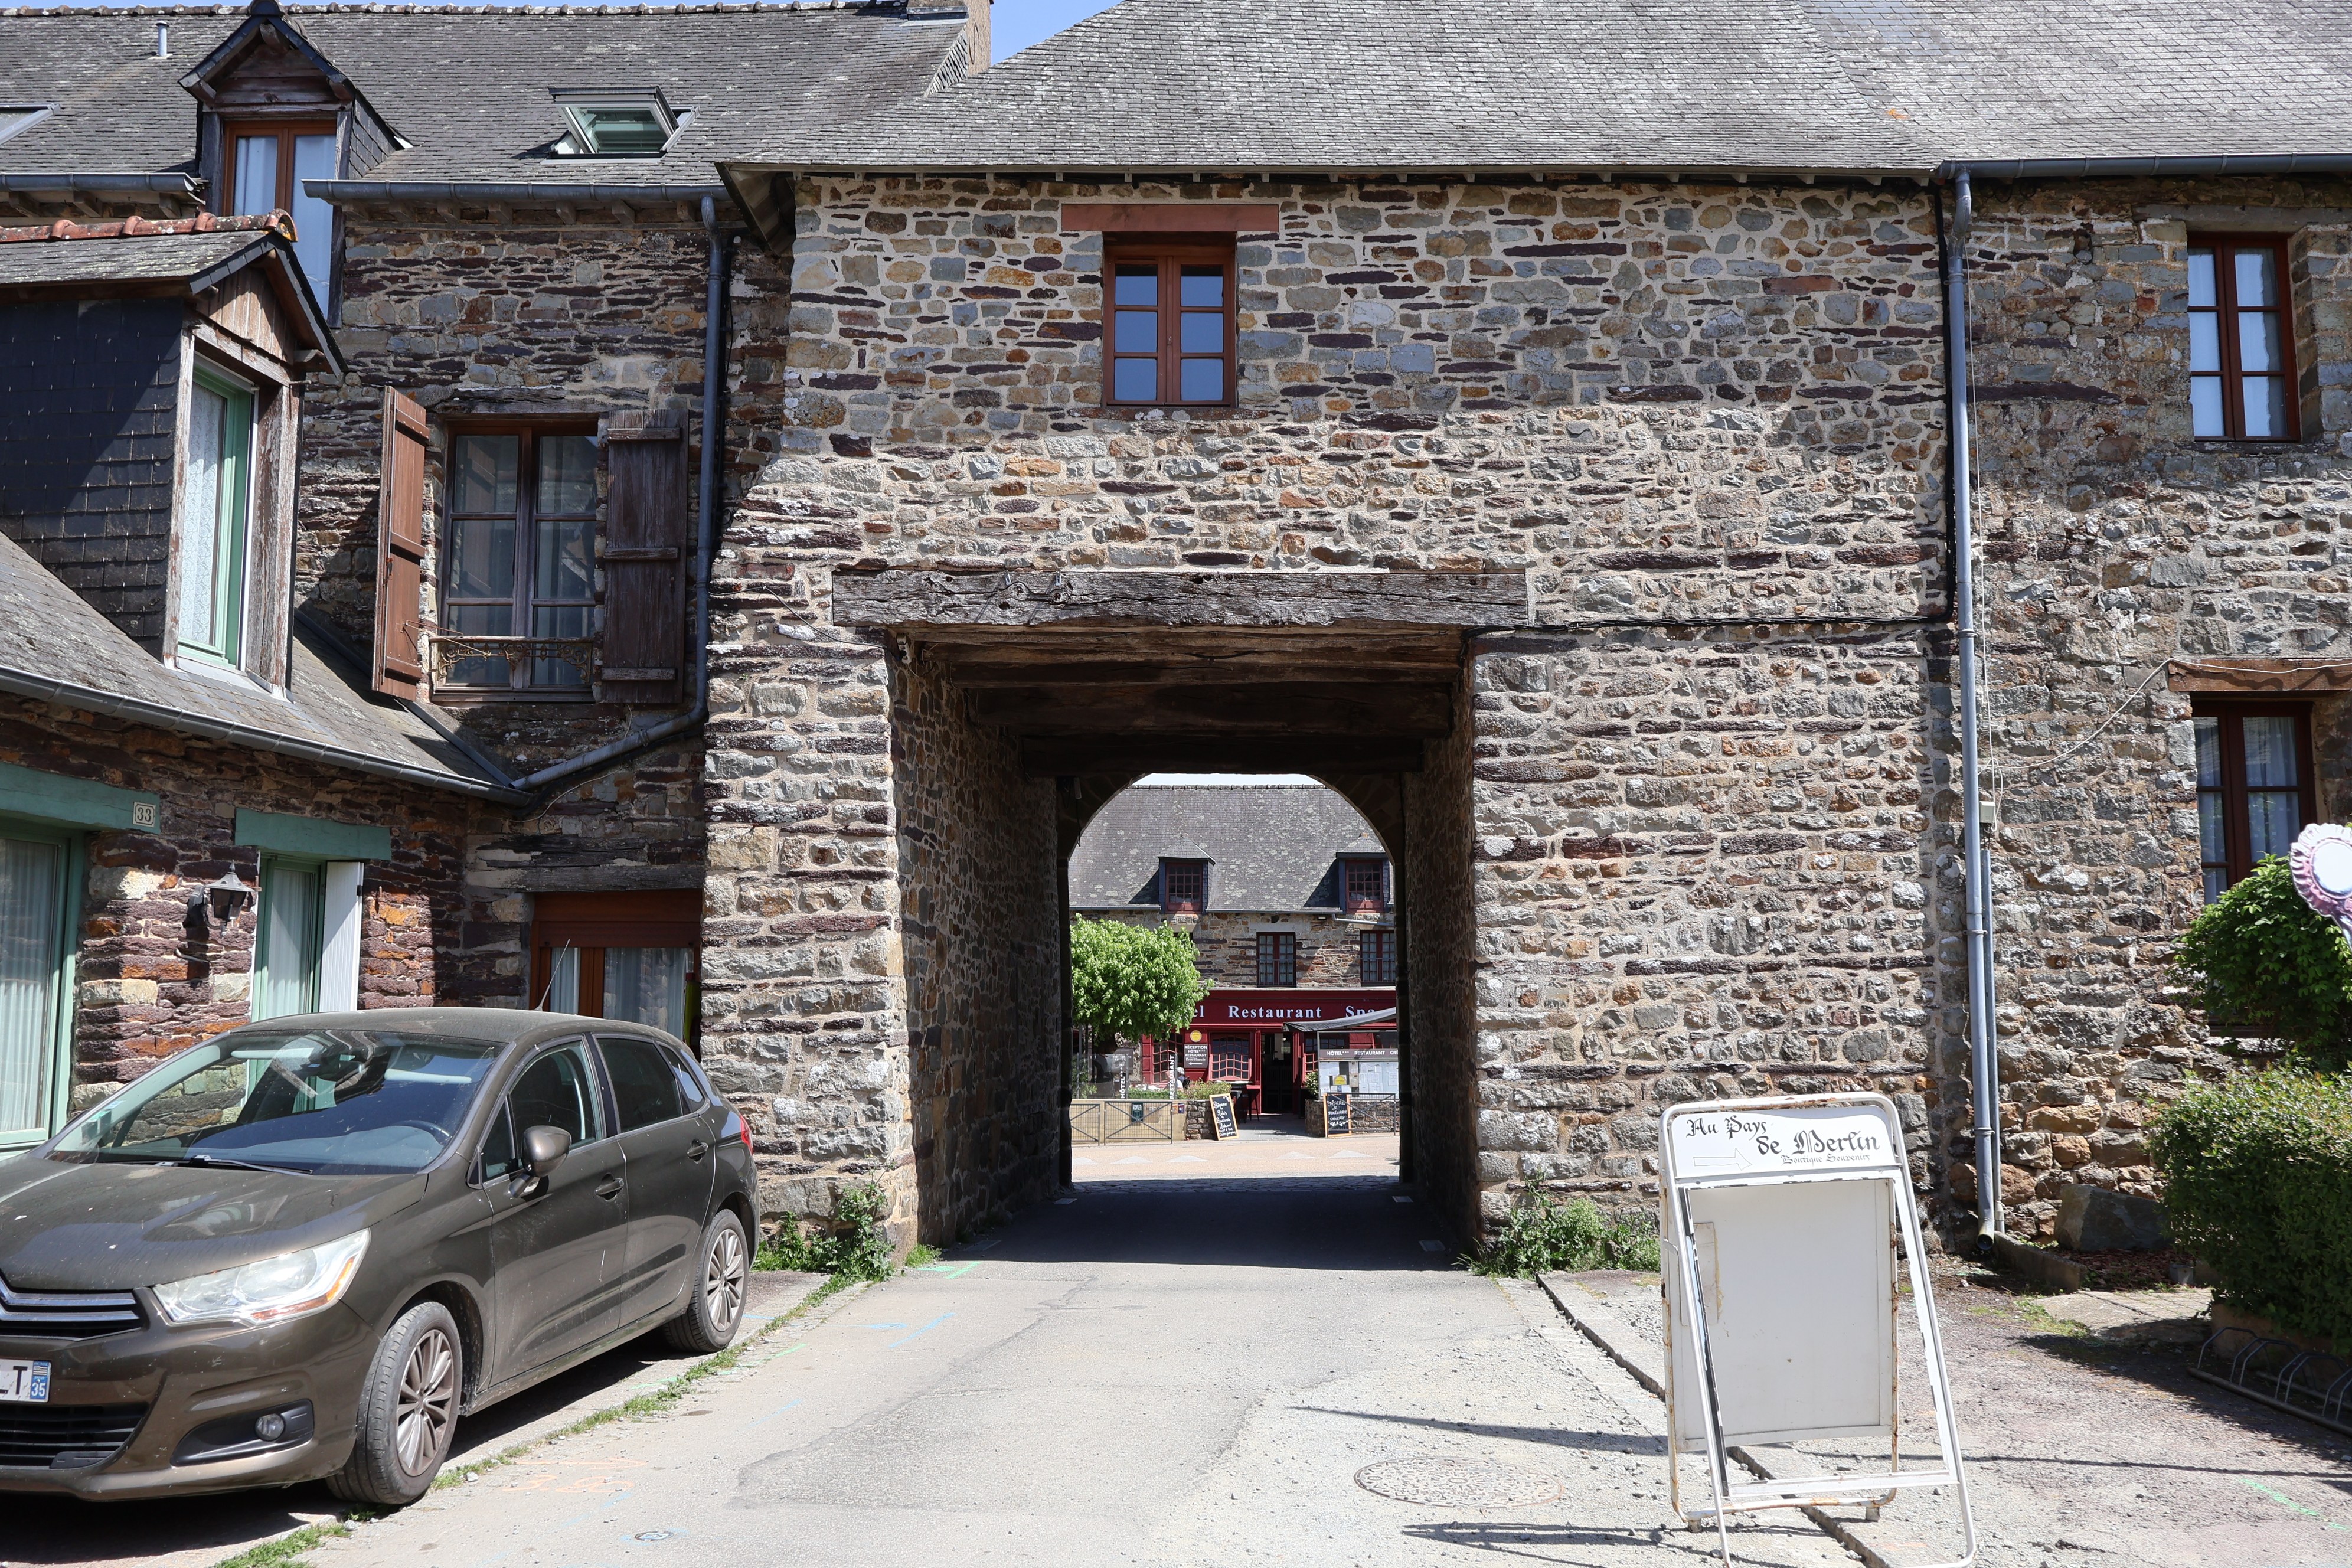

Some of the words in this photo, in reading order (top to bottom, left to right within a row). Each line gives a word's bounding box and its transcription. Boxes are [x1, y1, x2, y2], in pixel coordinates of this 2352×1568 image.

[137, 807, 151, 822] 33
[1228, 1005, 1322, 1018] Restaurant
[1686, 1117, 1719, 1138] Au
[1724, 1115, 1766, 1140] Pays
[1755, 1136, 1782, 1155] de
[1791, 1130, 1880, 1155] Merlin
[1781, 1155, 1822, 1167] Boutique
[1826, 1153, 1870, 1162] Souvenirs
[31, 1382, 46, 1397] 35
